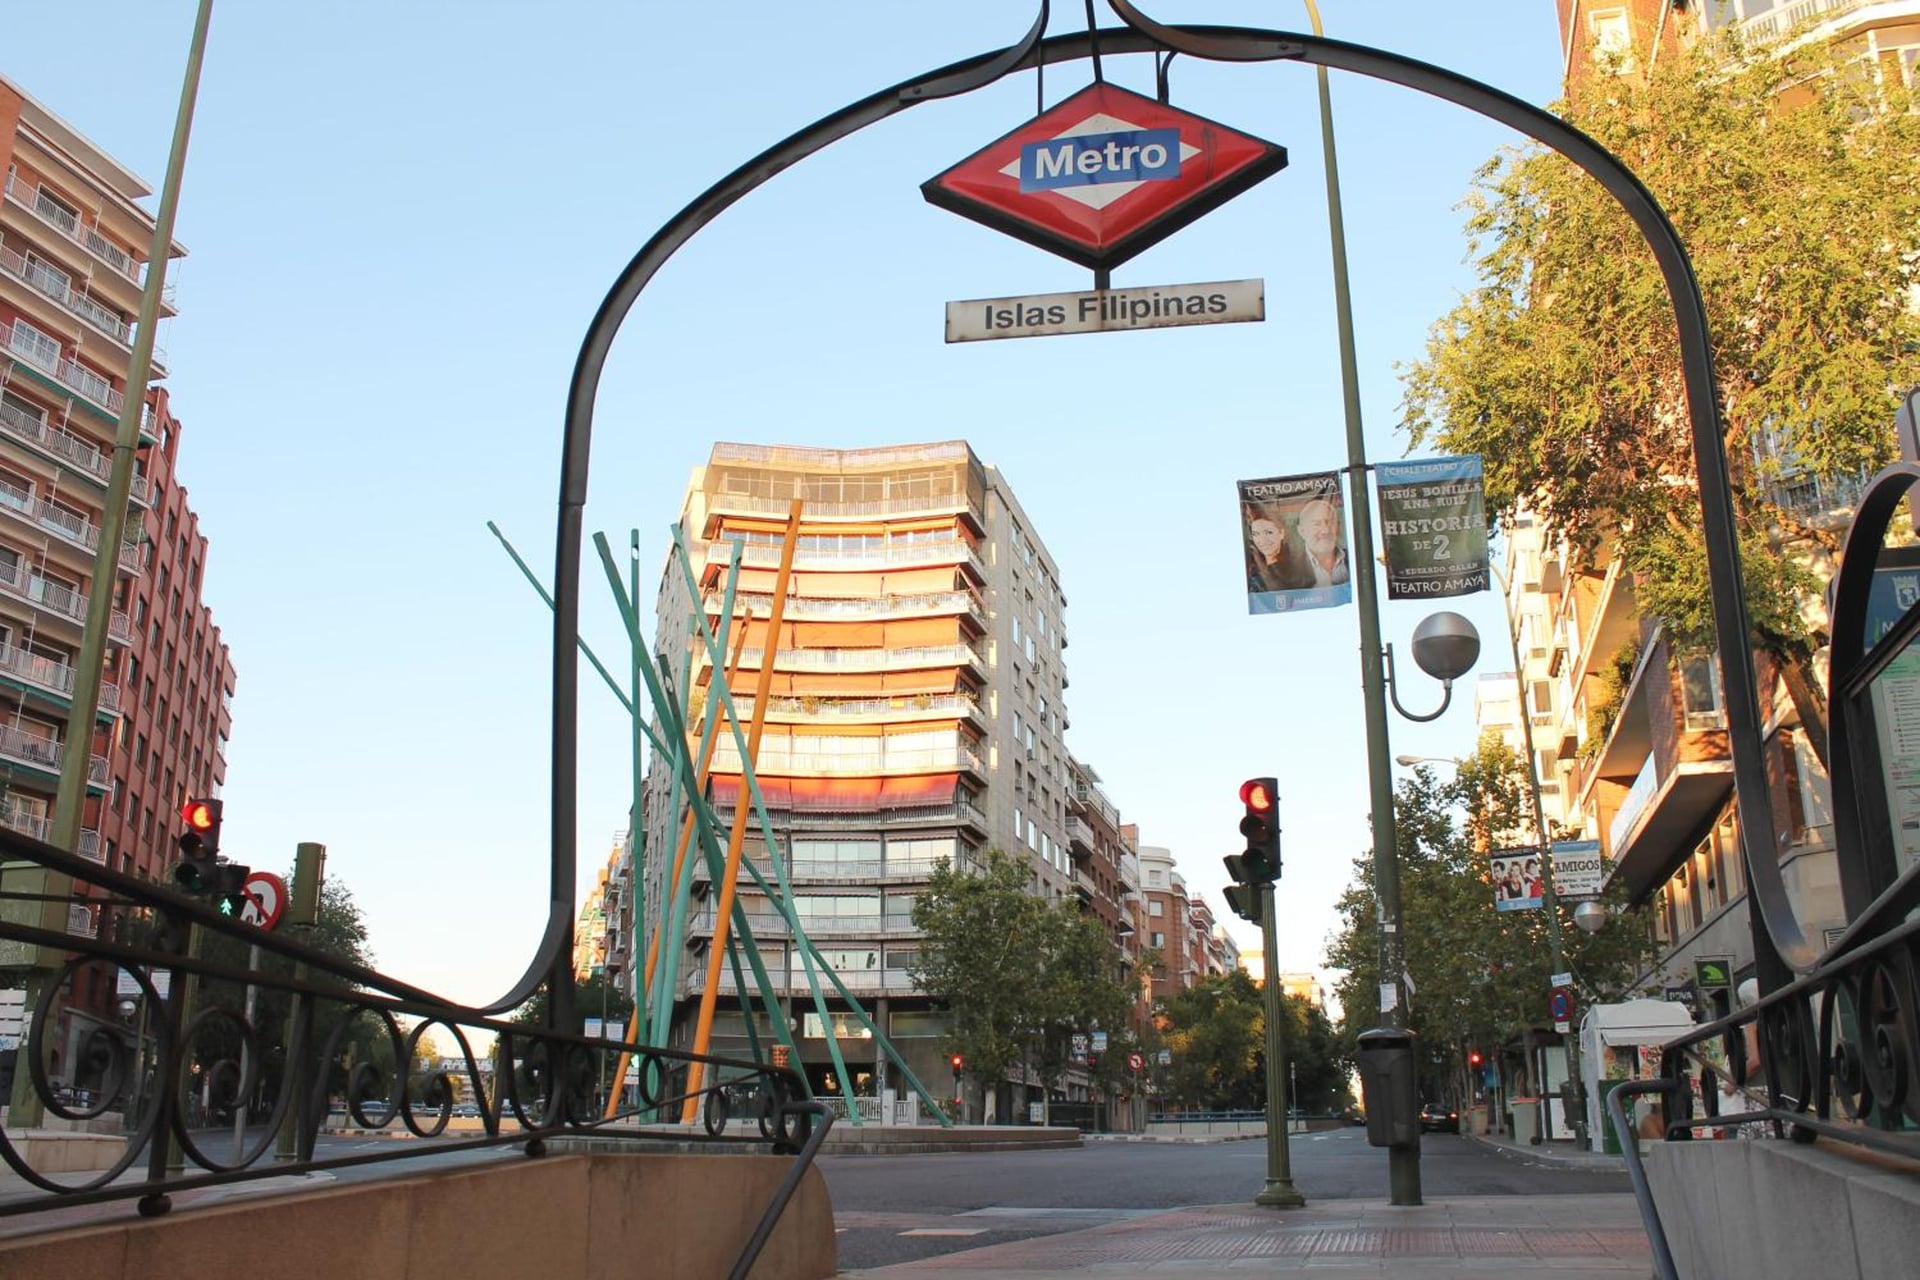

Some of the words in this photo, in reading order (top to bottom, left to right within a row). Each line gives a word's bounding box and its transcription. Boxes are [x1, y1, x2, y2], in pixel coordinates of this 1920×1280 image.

[1035, 141, 1167, 179] Metro
[984, 303, 1066, 330] Islas
[1078, 292, 1228, 324] Filipinas
[1245, 483, 1293, 497] TEATRO
[1295, 478, 1337, 491] AMAYA
[1423, 483, 1482, 497] BONILLA
[1402, 498, 1430, 510] ANA
[1436, 494, 1468, 507] RUIZ
[1384, 514, 1485, 535] HISTORIA
[1412, 540, 1432, 550] DE
[1433, 534, 1451, 560] 2
[1392, 580, 1441, 593] TEATRO
[1444, 575, 1485, 590] AMAYA
[1554, 859, 1600, 873] AMIGOS
